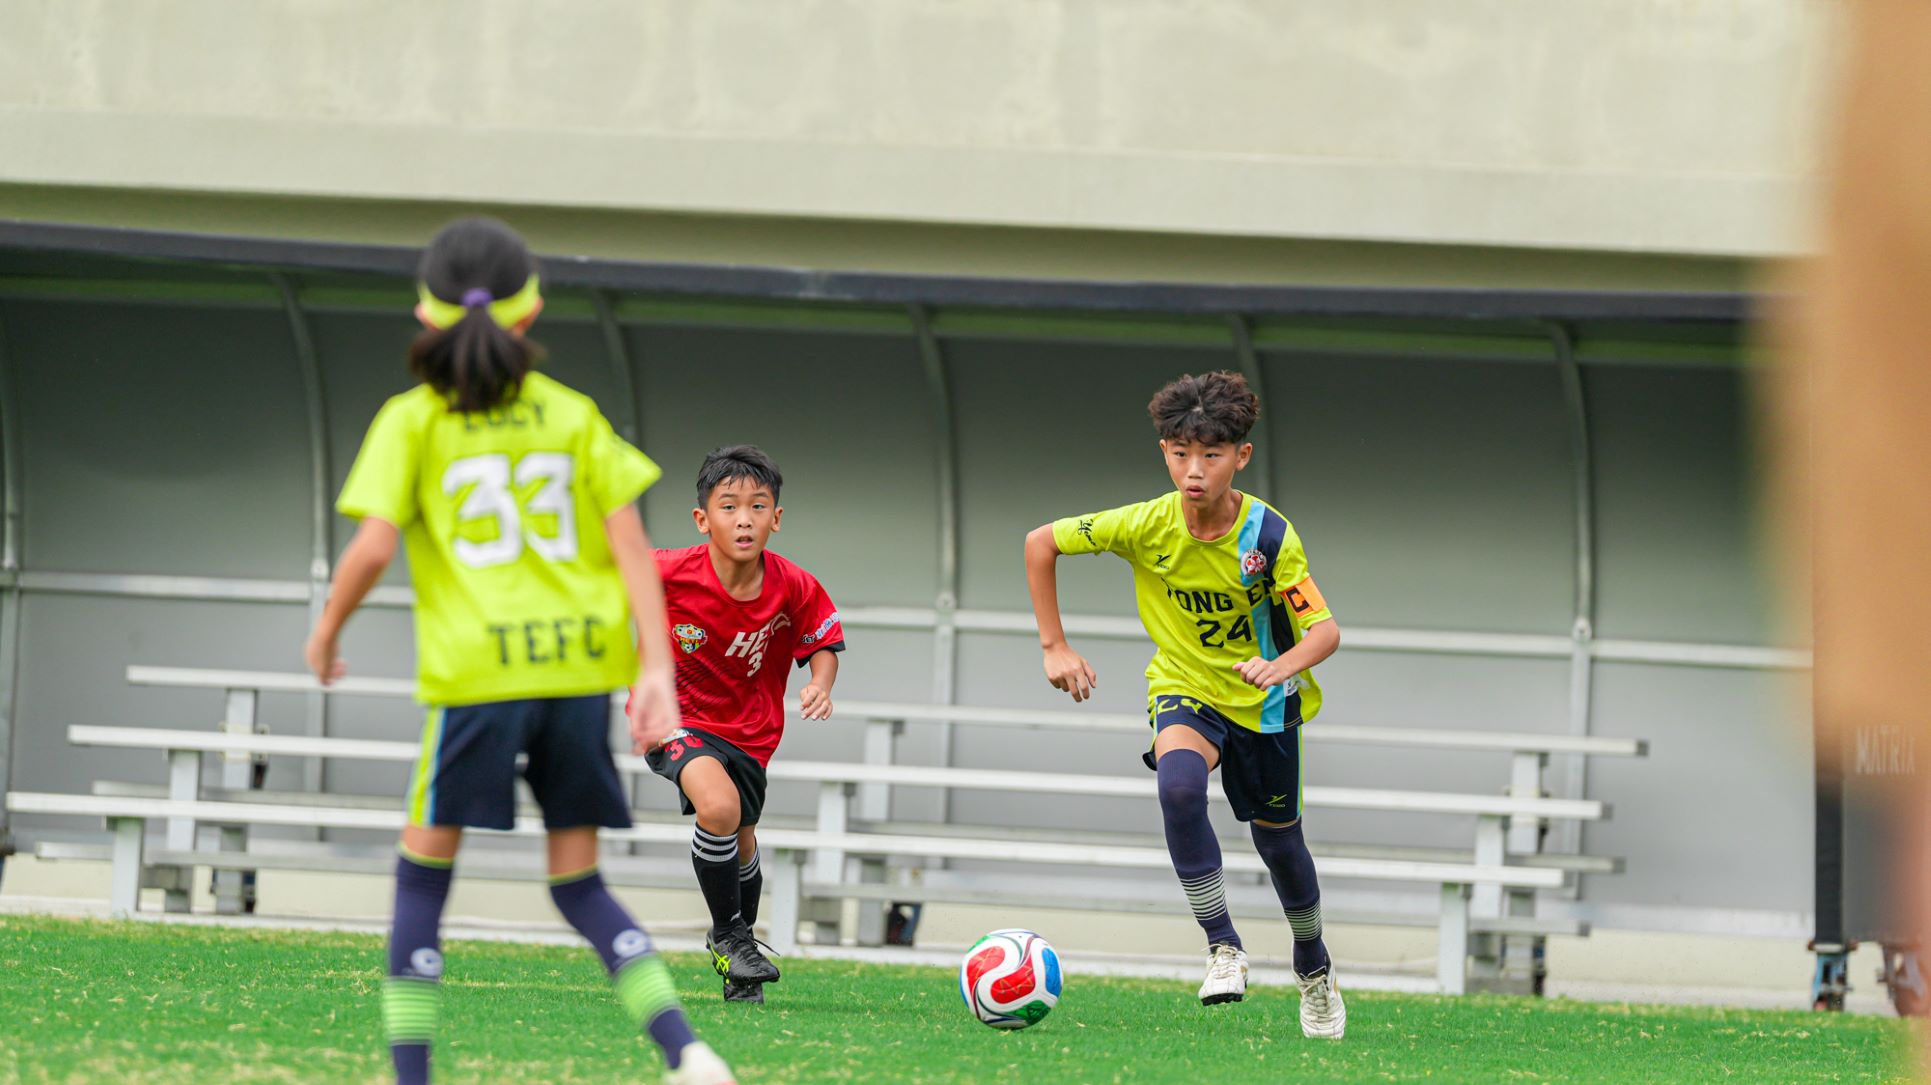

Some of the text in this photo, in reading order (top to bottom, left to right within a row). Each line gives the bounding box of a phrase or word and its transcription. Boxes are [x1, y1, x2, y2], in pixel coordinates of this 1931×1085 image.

[441, 452, 578, 569] 33
[1161, 576, 1234, 613] ONG
[1286, 587, 1310, 613] C
[489, 615, 607, 667] TEFC
[1195, 614, 1252, 649] 24
